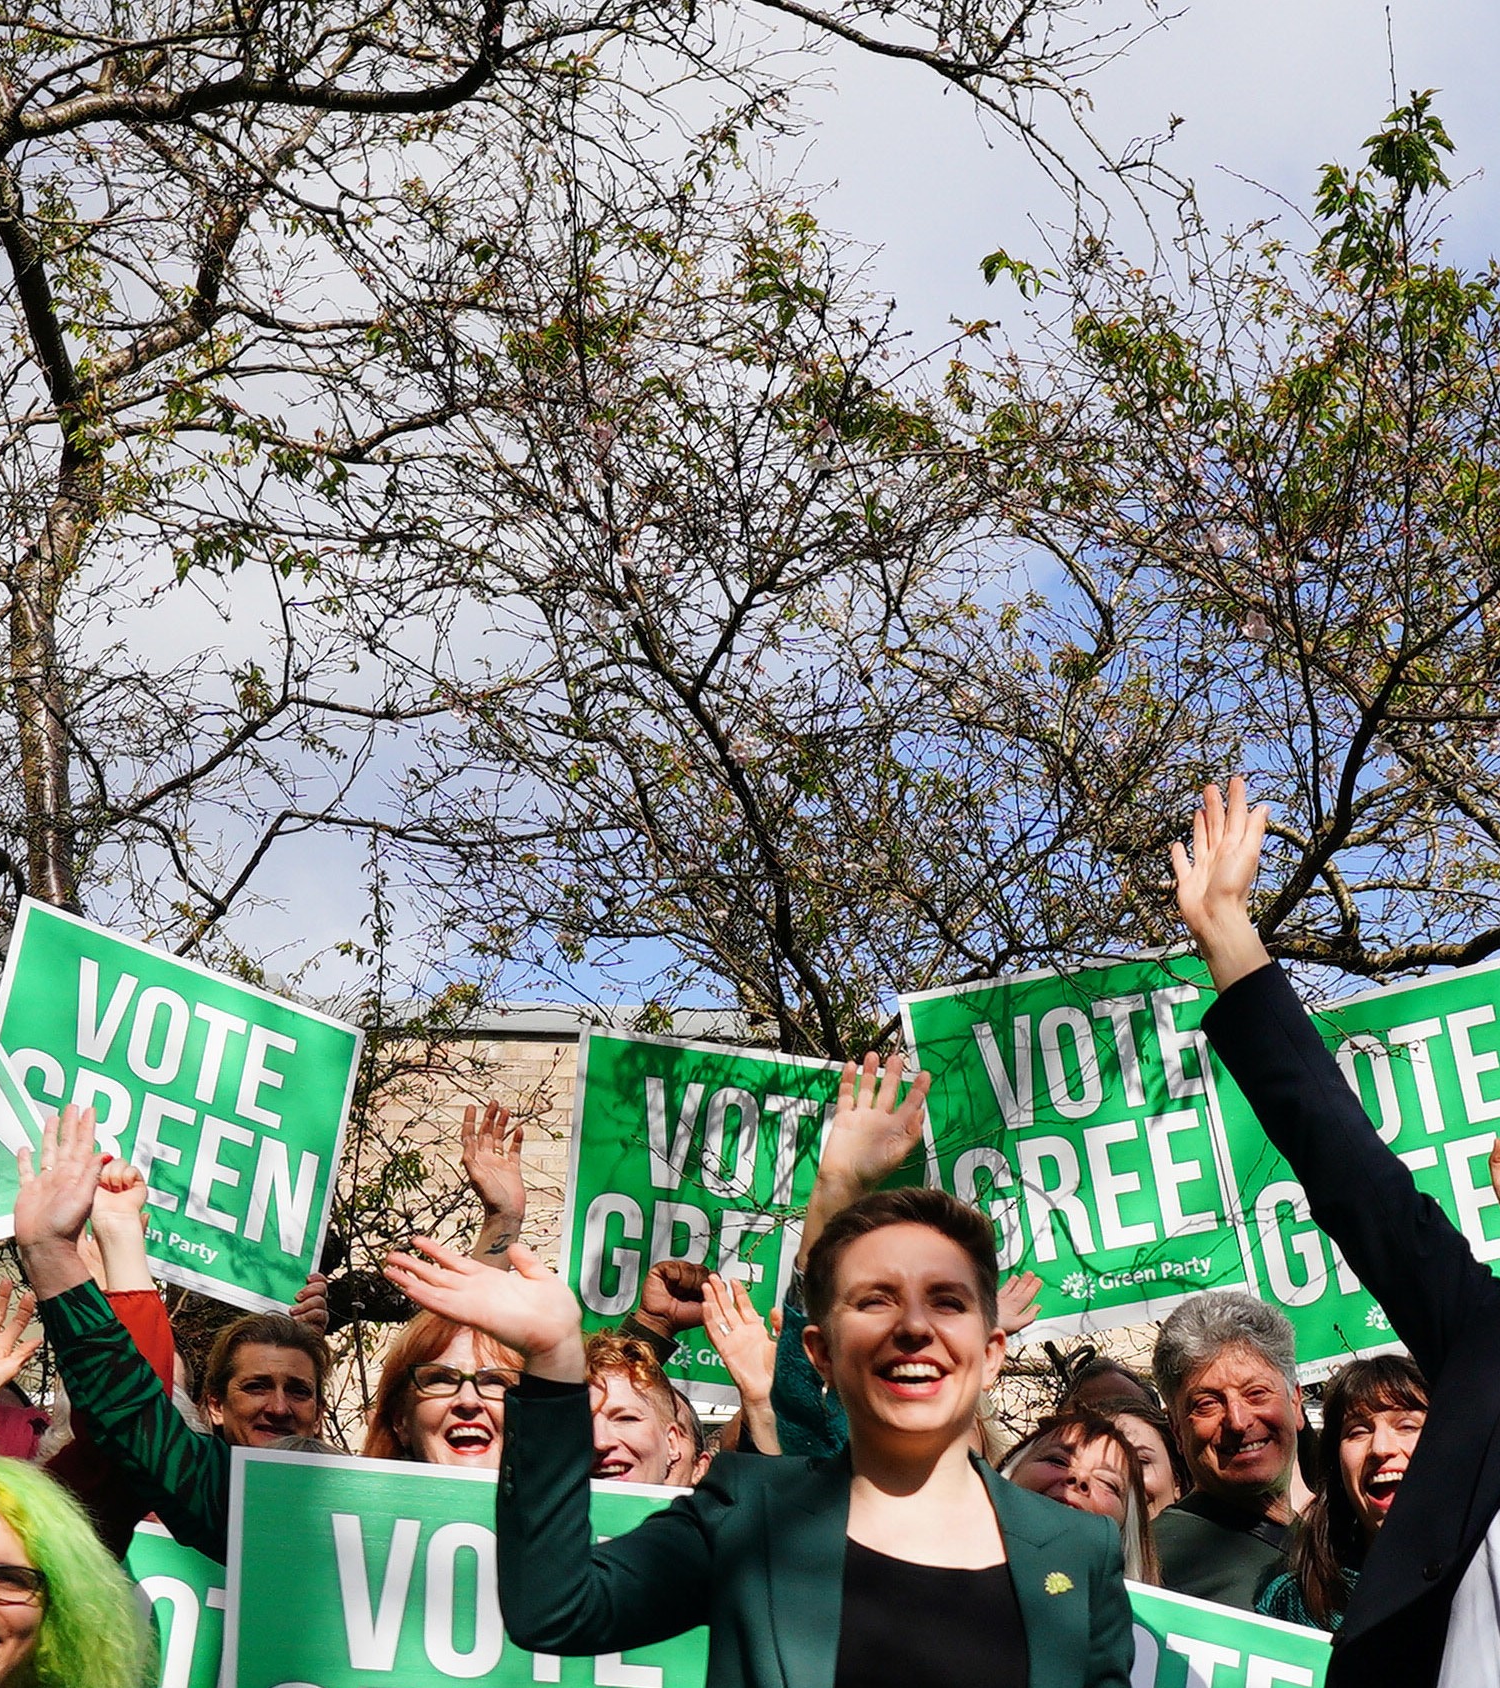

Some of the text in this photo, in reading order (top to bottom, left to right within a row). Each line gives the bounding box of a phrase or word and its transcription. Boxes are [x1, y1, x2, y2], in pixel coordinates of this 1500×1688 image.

[77, 956, 297, 1130] VOTE
[972, 984, 1205, 1130] VOTE
[645, 1076, 837, 1206] VOT
[953, 1107, 1218, 1271] GREE
[169, 1231, 218, 1265] Party
[579, 1192, 802, 1325] GRE
[1099, 1255, 1211, 1290] Green Party
